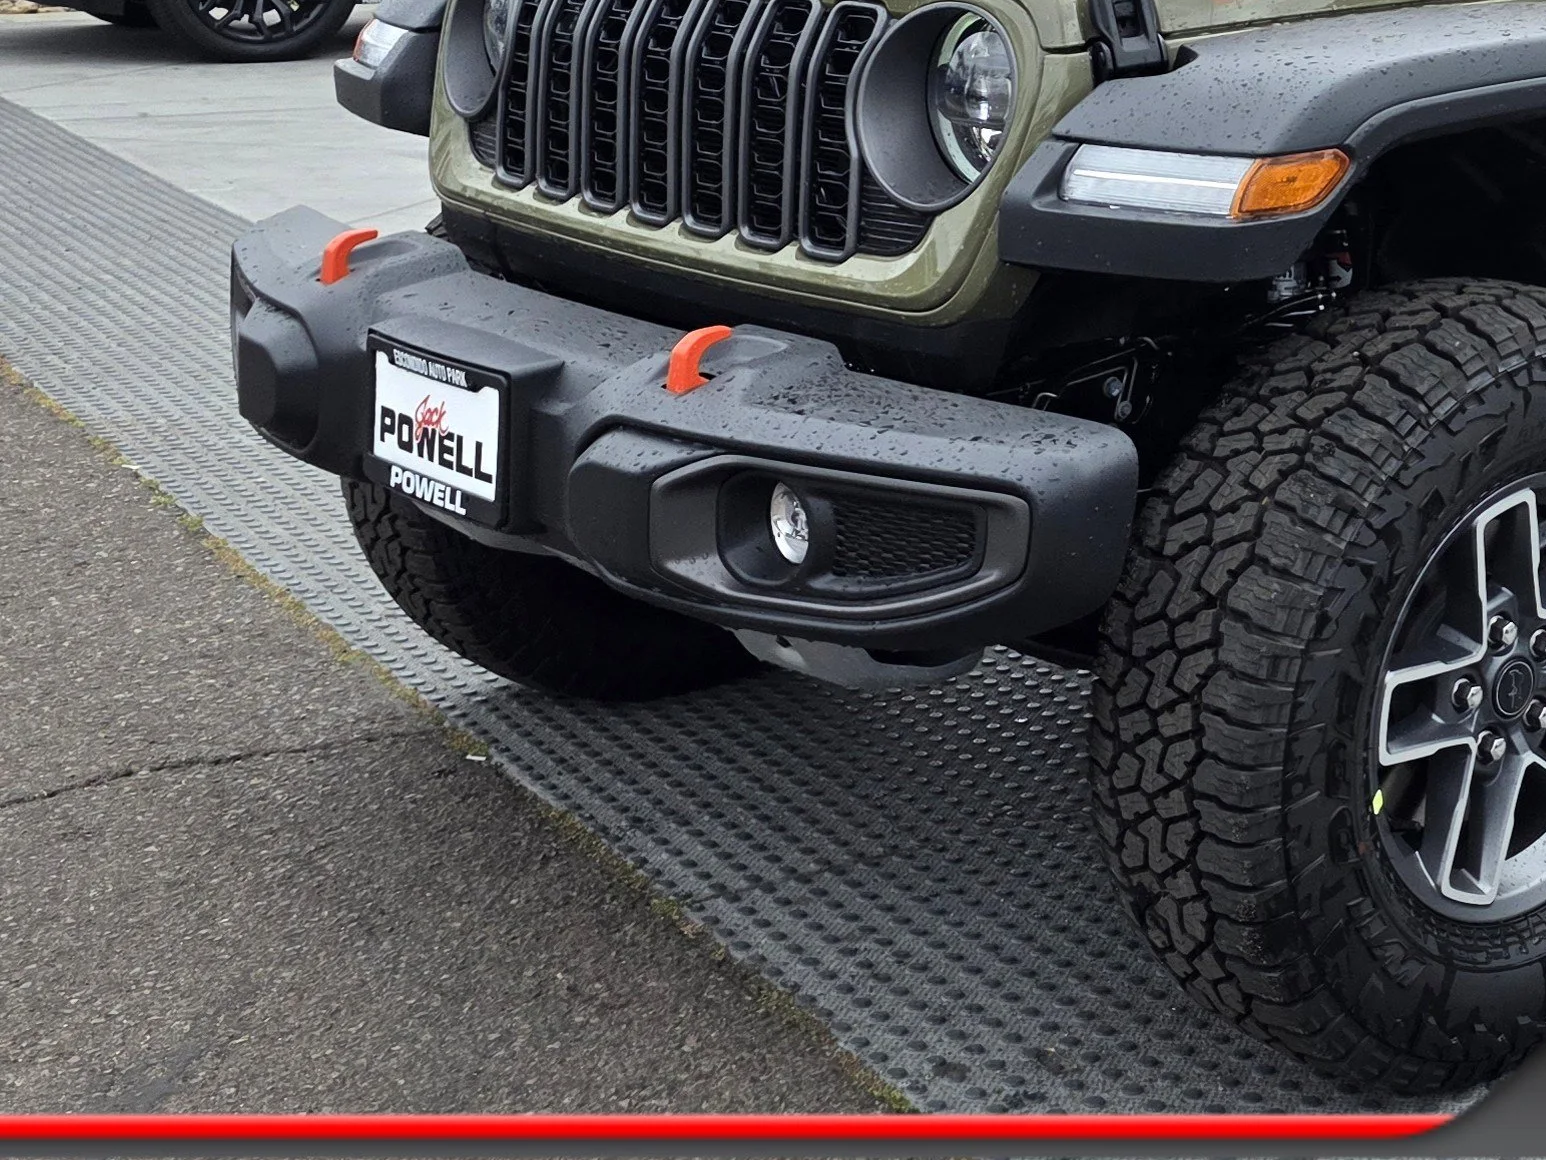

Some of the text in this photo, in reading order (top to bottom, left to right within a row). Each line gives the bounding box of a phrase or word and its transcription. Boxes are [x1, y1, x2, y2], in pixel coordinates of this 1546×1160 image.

[446, 367, 467, 388] PARK
[415, 394, 449, 443] Jack
[380, 405, 493, 484] POWELL
[390, 466, 466, 515] POWELL
